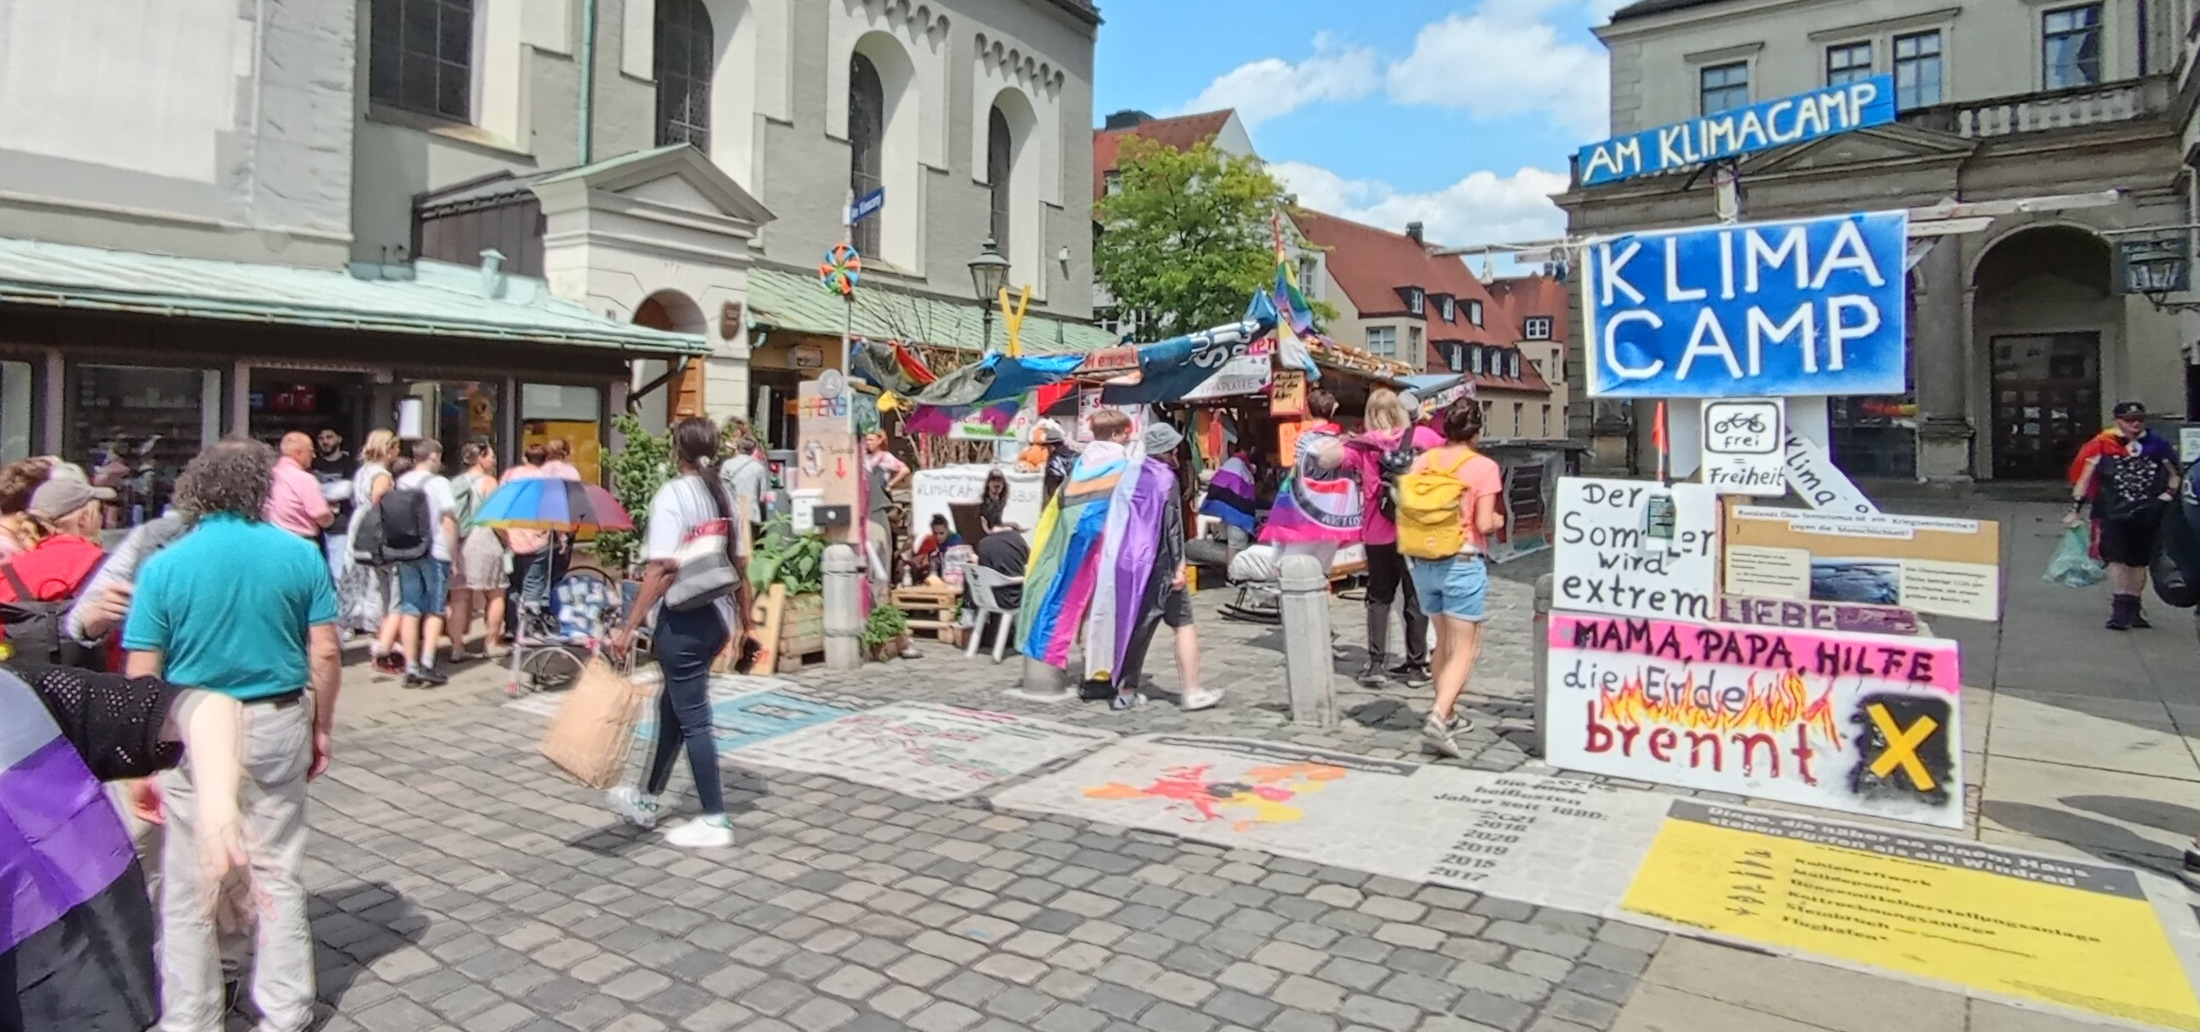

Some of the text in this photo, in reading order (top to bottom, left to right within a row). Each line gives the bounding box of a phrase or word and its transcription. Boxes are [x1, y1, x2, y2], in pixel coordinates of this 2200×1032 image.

[1582, 82, 1878, 182] AM KLIMACAMP
[1599, 220, 1885, 307] KLIMA
[1604, 293, 1881, 380] CAMP
[1724, 435, 1760, 448] frei
[1709, 465, 1784, 486] Freiheit
[1582, 483, 1643, 509] Der
[1562, 510, 1715, 557] Somer
[1598, 551, 1668, 577] wird
[1562, 573, 1714, 621] extrem
[1720, 597, 1836, 629] LIEBE
[1573, 618, 1934, 682] MAMA, PAPA, HILFE
[1563, 659, 1747, 713] die Erde
[1583, 700, 1817, 787] brennt
[1433, 792, 1495, 806] Jahre
[1500, 800, 1542, 811] seit
[1451, 840, 1511, 856] 2019
[1462, 829, 1521, 844] 2020
[1707, 806, 1776, 826] Dinge,
[1781, 819, 1817, 832] die
[1896, 837, 1927, 850] an
[1932, 844, 2013, 865] einem
[2018, 858, 2091, 878] Haus
[1428, 866, 1489, 882] 2017
[1440, 853, 1498, 869] 2015
[1914, 851, 1956, 865] ein
[1961, 857, 2077, 887] Windrad
